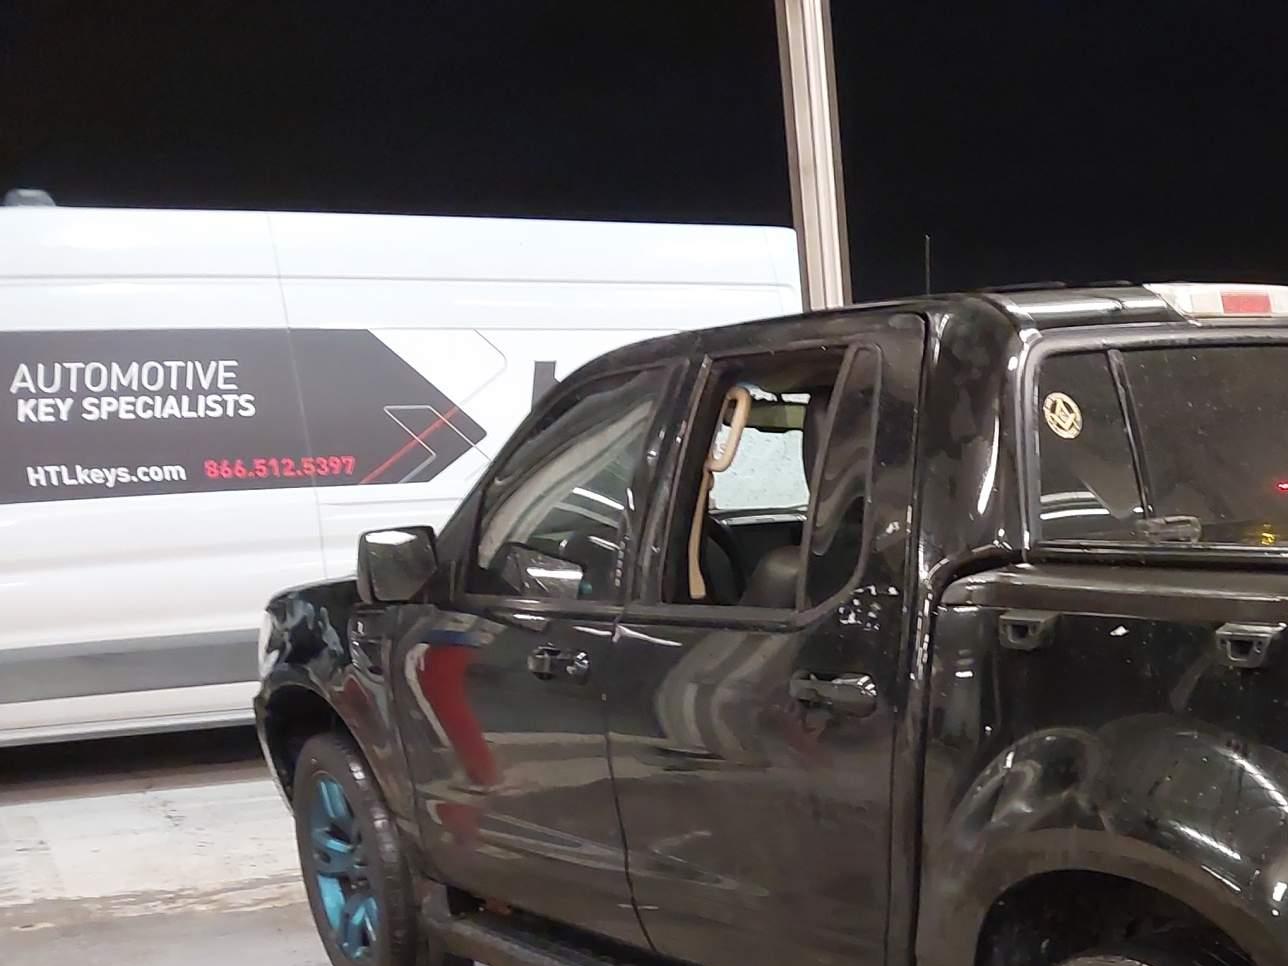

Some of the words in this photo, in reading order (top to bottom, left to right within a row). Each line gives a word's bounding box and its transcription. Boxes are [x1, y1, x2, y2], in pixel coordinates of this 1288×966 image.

[9, 360, 240, 394] AUTOMOTIVE
[16, 397, 75, 423] KEY
[81, 393, 257, 421] SPECIALISTS
[26, 464, 188, 488] HTLkeys.com
[203, 455, 356, 479] 866.512.5397
